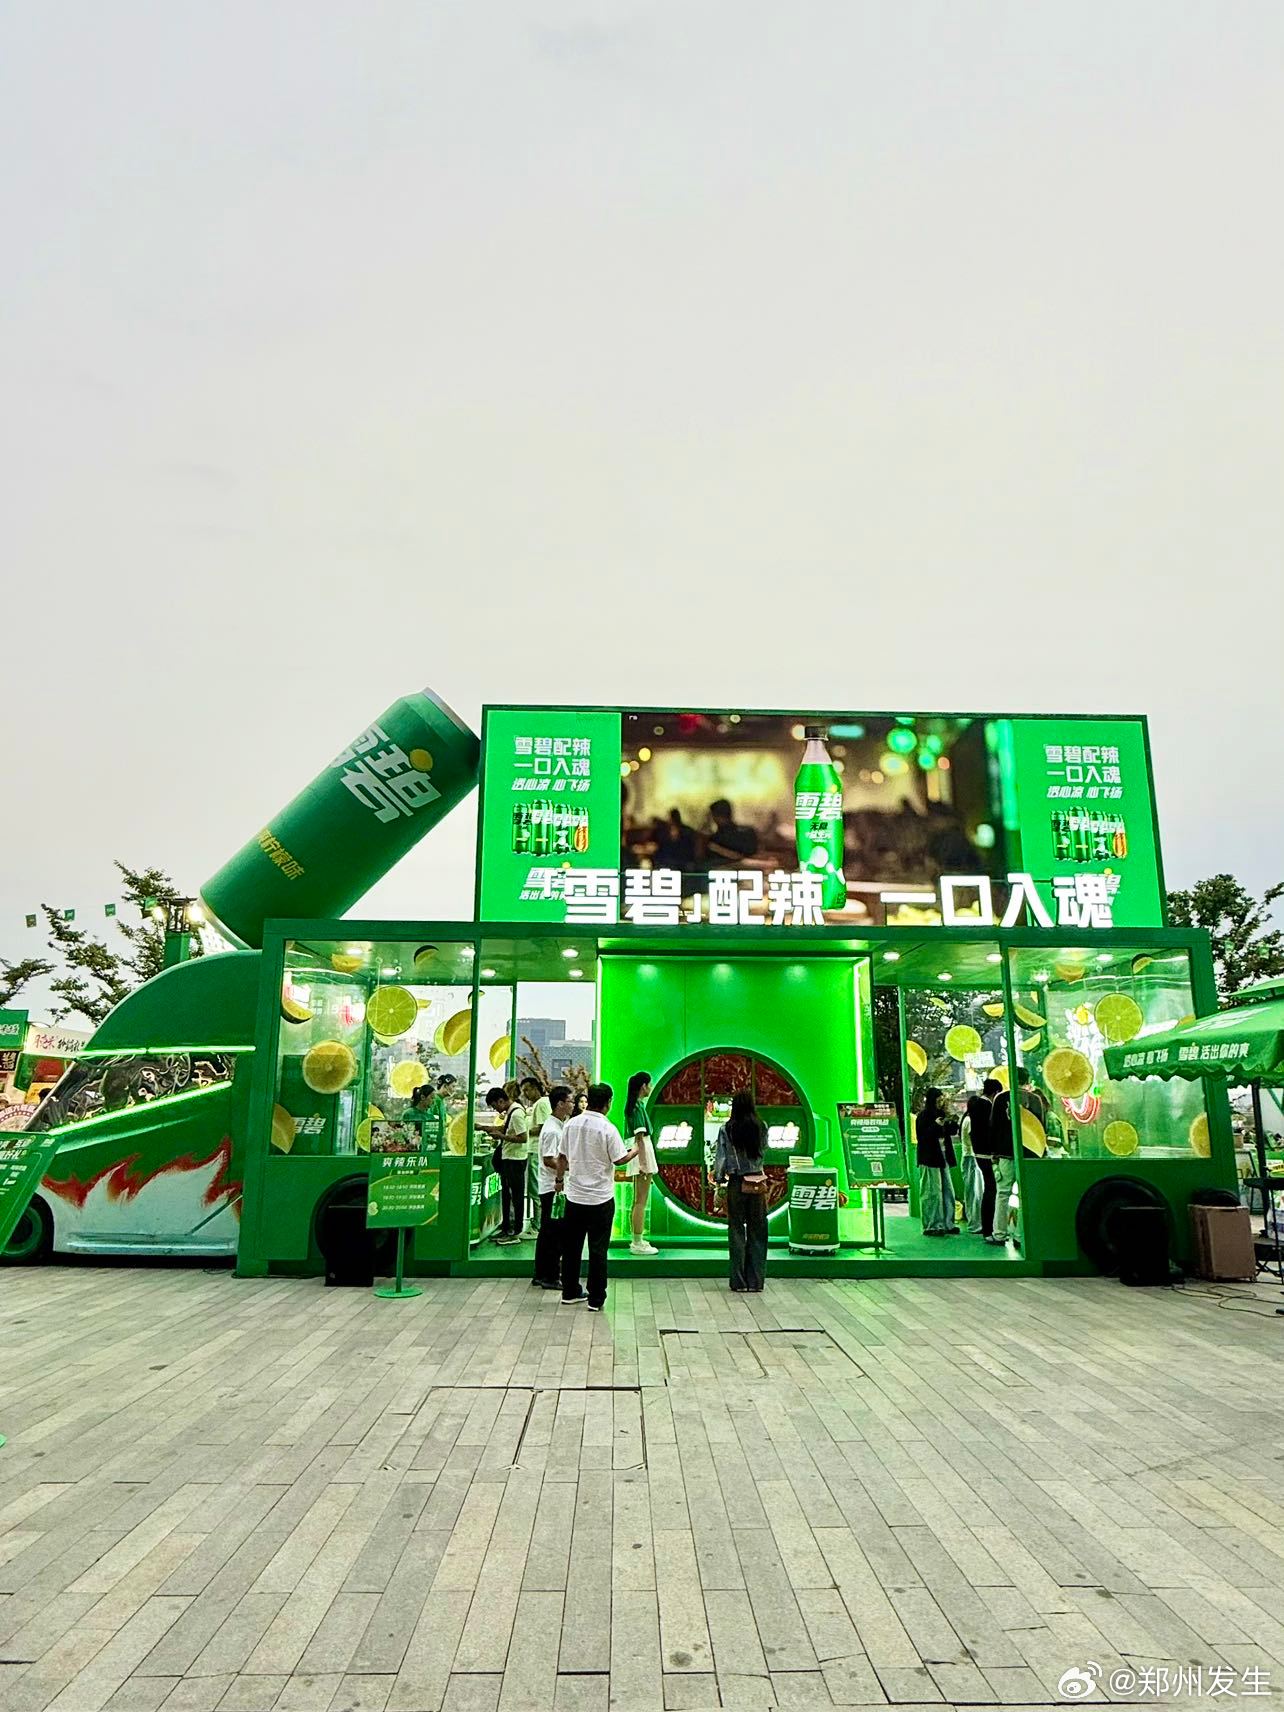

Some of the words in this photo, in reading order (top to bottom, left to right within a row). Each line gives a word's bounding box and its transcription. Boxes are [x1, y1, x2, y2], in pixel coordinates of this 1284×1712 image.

[513, 758, 591, 776] 一口入魂
[1046, 766, 1122, 784] 一口入魂
[552, 778, 592, 792] 心飞扬
[794, 792, 843, 820] 雪碧
[879, 872, 1115, 929] 一口入魂
[1200, 1042, 1250, 1060] 活出你的爽
[789, 1185, 838, 1210] 雪碧
